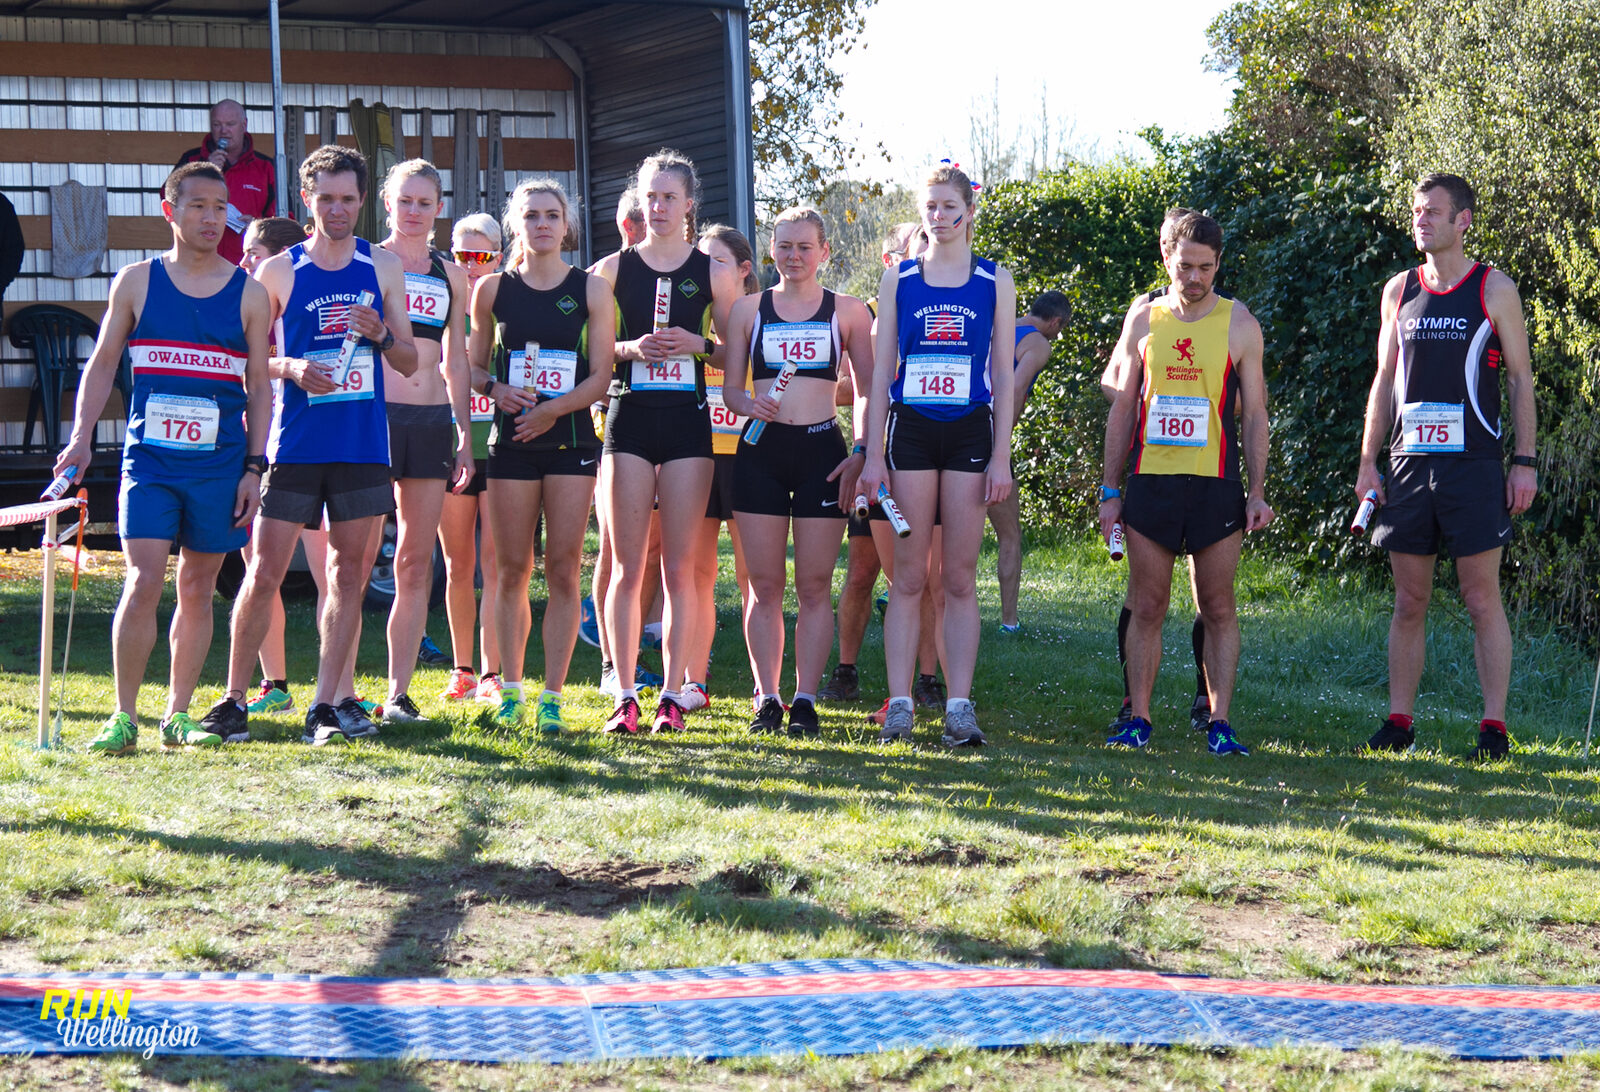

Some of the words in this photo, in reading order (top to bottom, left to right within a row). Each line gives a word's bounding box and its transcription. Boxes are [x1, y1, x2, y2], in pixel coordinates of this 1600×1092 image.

[914, 304, 977, 320] WELLINGTON
[1405, 318, 1468, 330] OLYMPIC
[1404, 332, 1466, 340] WELLINGTON
[148, 351, 231, 369] OWAIRAKA
[778, 342, 816, 360] 145
[646, 362, 682, 381] 144
[1166, 366, 1203, 374] Wellington
[1166, 373, 1198, 381] Scottish
[775, 370, 793, 393] 145
[919, 376, 955, 395] 148
[162, 419, 202, 442] 176
[808, 422, 831, 433] NIKE
[1158, 418, 1194, 437] 180
[1416, 424, 1449, 442] 175
